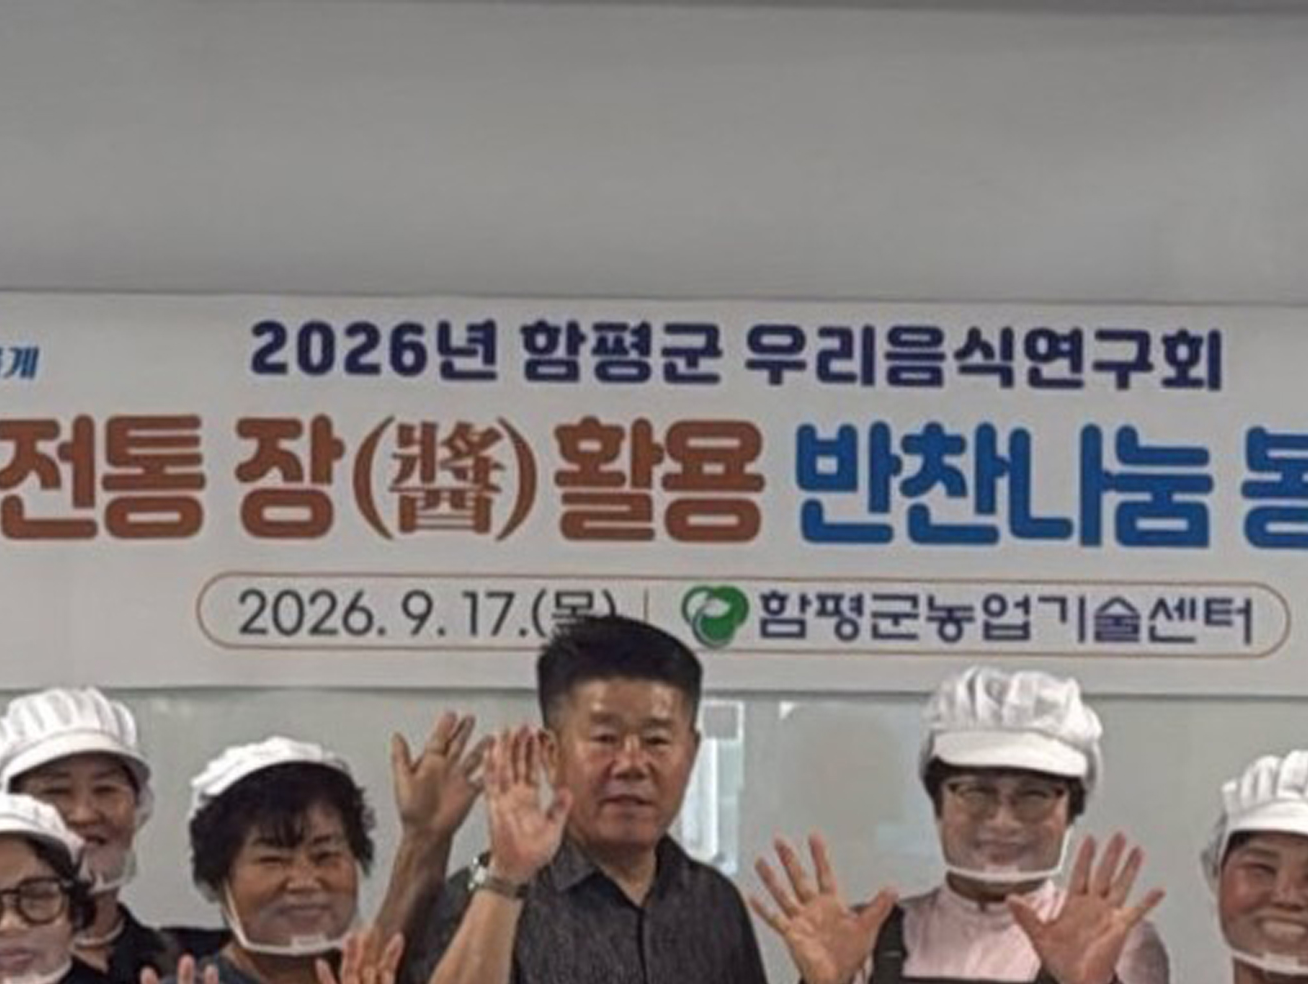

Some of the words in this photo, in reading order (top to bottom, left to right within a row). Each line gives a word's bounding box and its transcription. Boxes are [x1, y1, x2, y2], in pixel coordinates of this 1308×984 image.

[250, 318, 499, 381] 2026년
[522, 320, 722, 386] 함평군
[744, 322, 1224, 391] 우리음식연구회
[235, 414, 538, 542] 장(醬)
[554, 418, 764, 544] 활용
[796, 422, 1213, 550] 반찬나눔
[239, 590, 386, 637] 2026.
[402, 590, 446, 637] 9.
[760, 589, 1253, 646] 함평군농업기술센터
